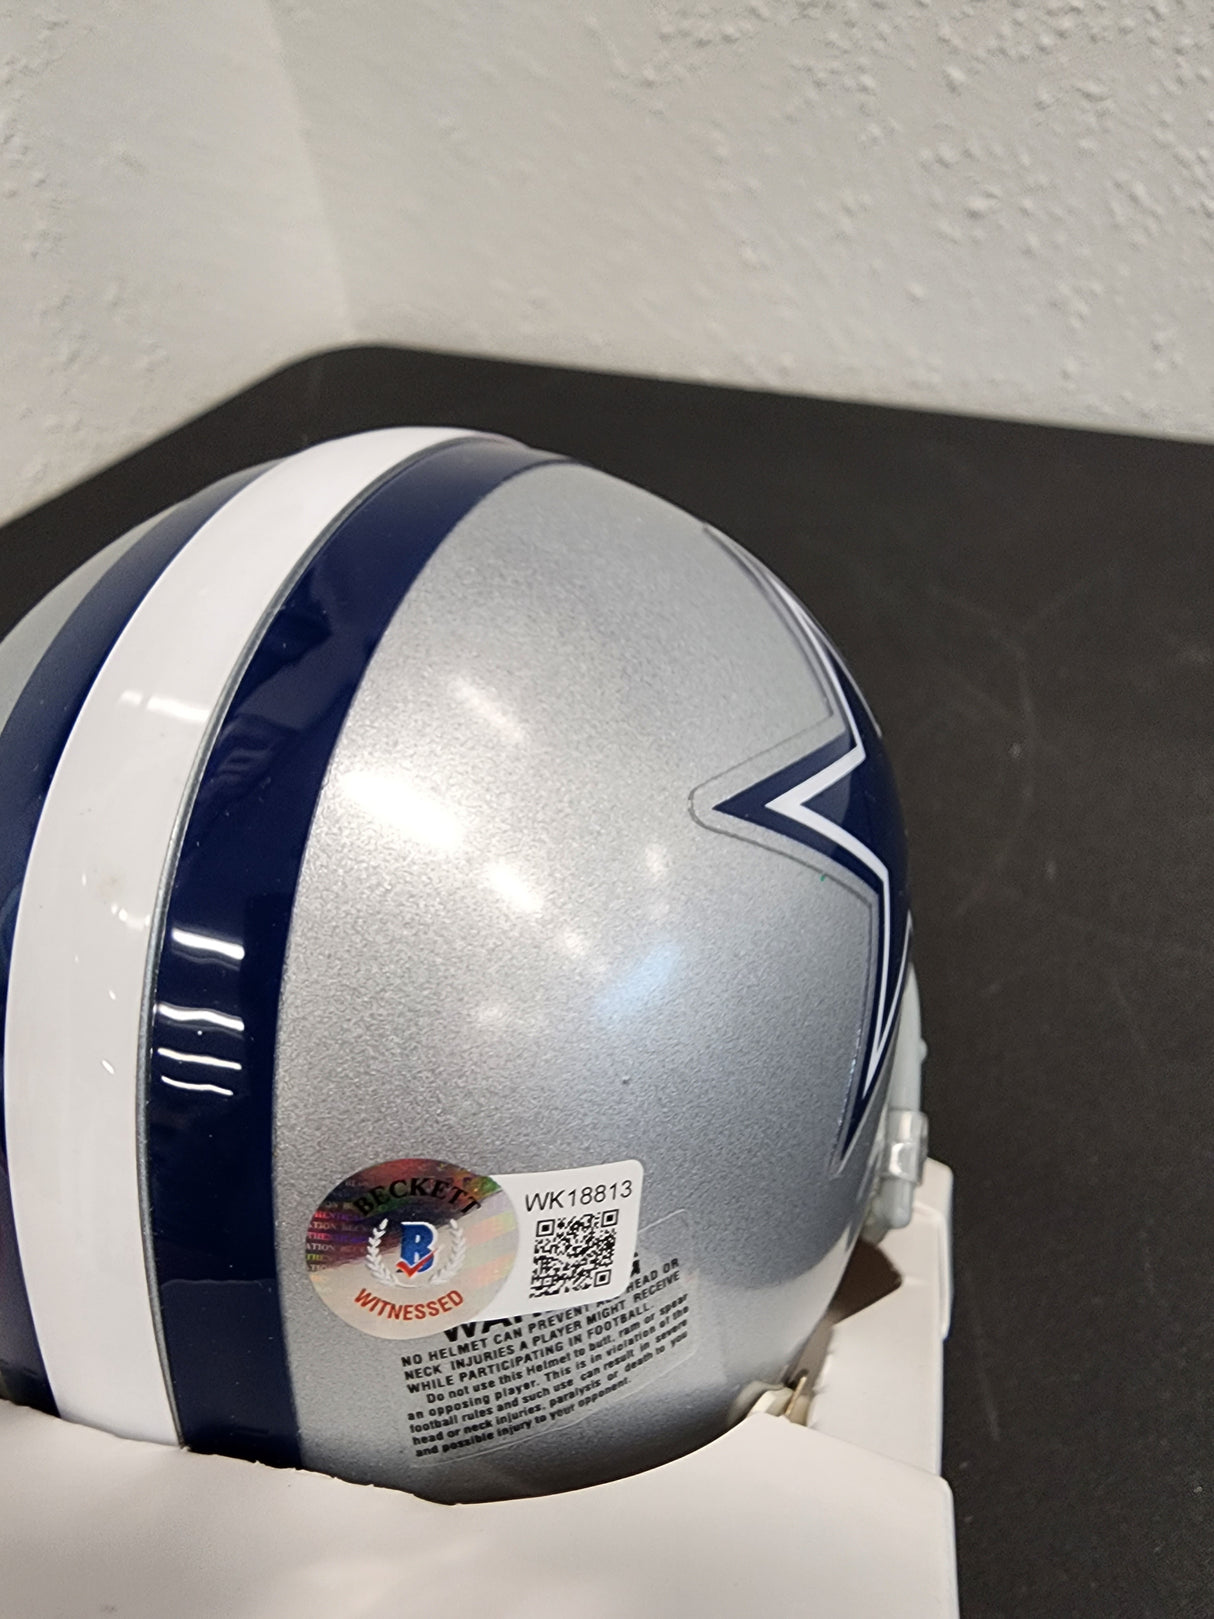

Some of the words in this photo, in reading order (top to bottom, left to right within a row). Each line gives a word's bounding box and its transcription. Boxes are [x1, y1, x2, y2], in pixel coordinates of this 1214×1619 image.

[352, 1177, 481, 1217] BECKETT
[525, 1179, 633, 1212] WK18813
[354, 1288, 463, 1320] WITNESSED
[401, 1354, 423, 1367] NO
[428, 1338, 488, 1361] HELMET
[494, 1328, 522, 1344] CAN
[528, 1305, 589, 1333] PREVENT
[626, 1270, 658, 1293] HEAD
[663, 1258, 679, 1273] OR
[404, 1365, 442, 1380] NECK
[451, 1345, 515, 1370] INJURIES
[519, 1341, 528, 1351] A
[532, 1321, 582, 1346] PLAYER
[586, 1300, 626, 1326] MIGHT
[633, 1270, 680, 1303] RECEIVE
[407, 1375, 454, 1394] WHILE
[459, 1342, 563, 1382] PARTICIPATING
[568, 1334, 582, 1347] IN
[587, 1303, 654, 1339] FOOTBALL.
[426, 1393, 445, 1404] Do
[448, 1386, 469, 1398] not
[472, 1380, 496, 1392] use
[498, 1372, 523, 1385] this
[526, 1353, 571, 1375] Helmet
[573, 1348, 585, 1358] to
[618, 1322, 640, 1337] ram
[644, 1313, 656, 1324] or
[659, 1293, 688, 1316] spear
[407, 1411, 424, 1421] an
[428, 1395, 490, 1417] opposing
[495, 1379, 540, 1401] player.
[544, 1366, 571, 1382] This
[575, 1360, 587, 1370] is
[590, 1353, 602, 1364] in
[606, 1326, 656, 1356] violation
[659, 1316, 670, 1328] of
[673, 1306, 689, 1320] the
[409, 1415, 458, 1433] football
[461, 1407, 494, 1422] rules
[496, 1397, 519, 1412] and
[522, 1387, 550, 1404] such
[553, 1378, 574, 1392] use
[580, 1367, 601, 1381] can
[603, 1350, 634, 1370] result
[639, 1341, 650, 1352] in
[655, 1319, 688, 1343] severe
[412, 1431, 444, 1446] head
[447, 1428, 461, 1438] or
[463, 1420, 493, 1434] neck
[549, 1378, 601, 1408] paralysis
[607, 1371, 618, 1382] or
[624, 1352, 653, 1372] death
[671, 1331, 688, 1347] you
[415, 1445, 439, 1458] and
[442, 1432, 494, 1453] possible
[497, 1420, 532, 1436] injury
[534, 1414, 547, 1424] to
[549, 1404, 575, 1421] your
